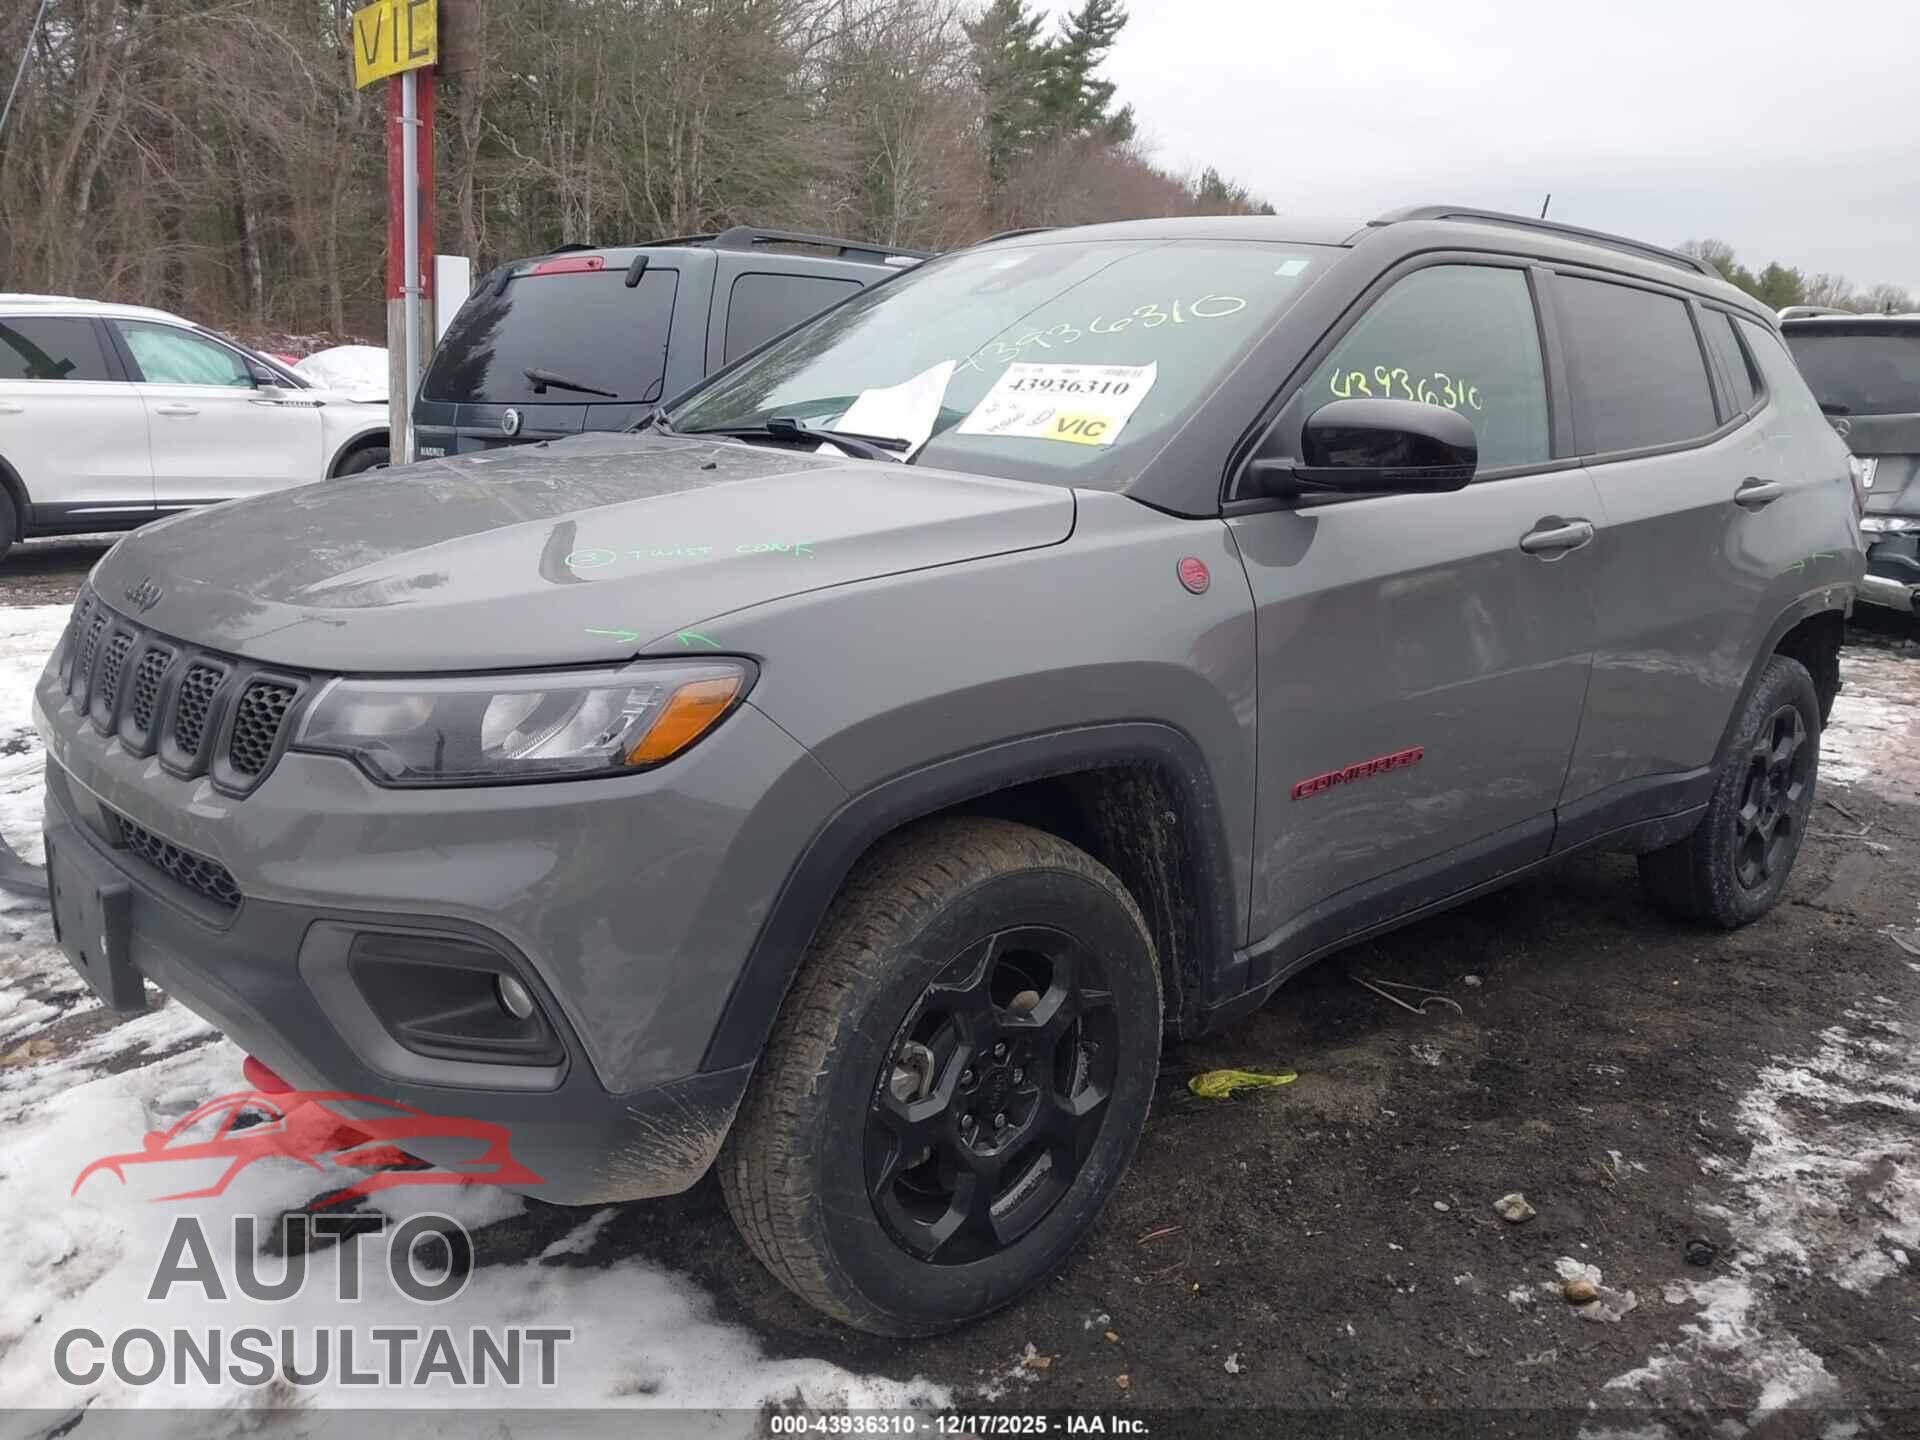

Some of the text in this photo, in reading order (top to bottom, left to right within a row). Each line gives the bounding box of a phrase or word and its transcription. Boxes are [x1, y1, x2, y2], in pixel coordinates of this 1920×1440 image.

[1008, 377, 1131, 396] 43936310
[1056, 416, 1108, 438] VIC
[1290, 745, 1425, 800] COMPASS
